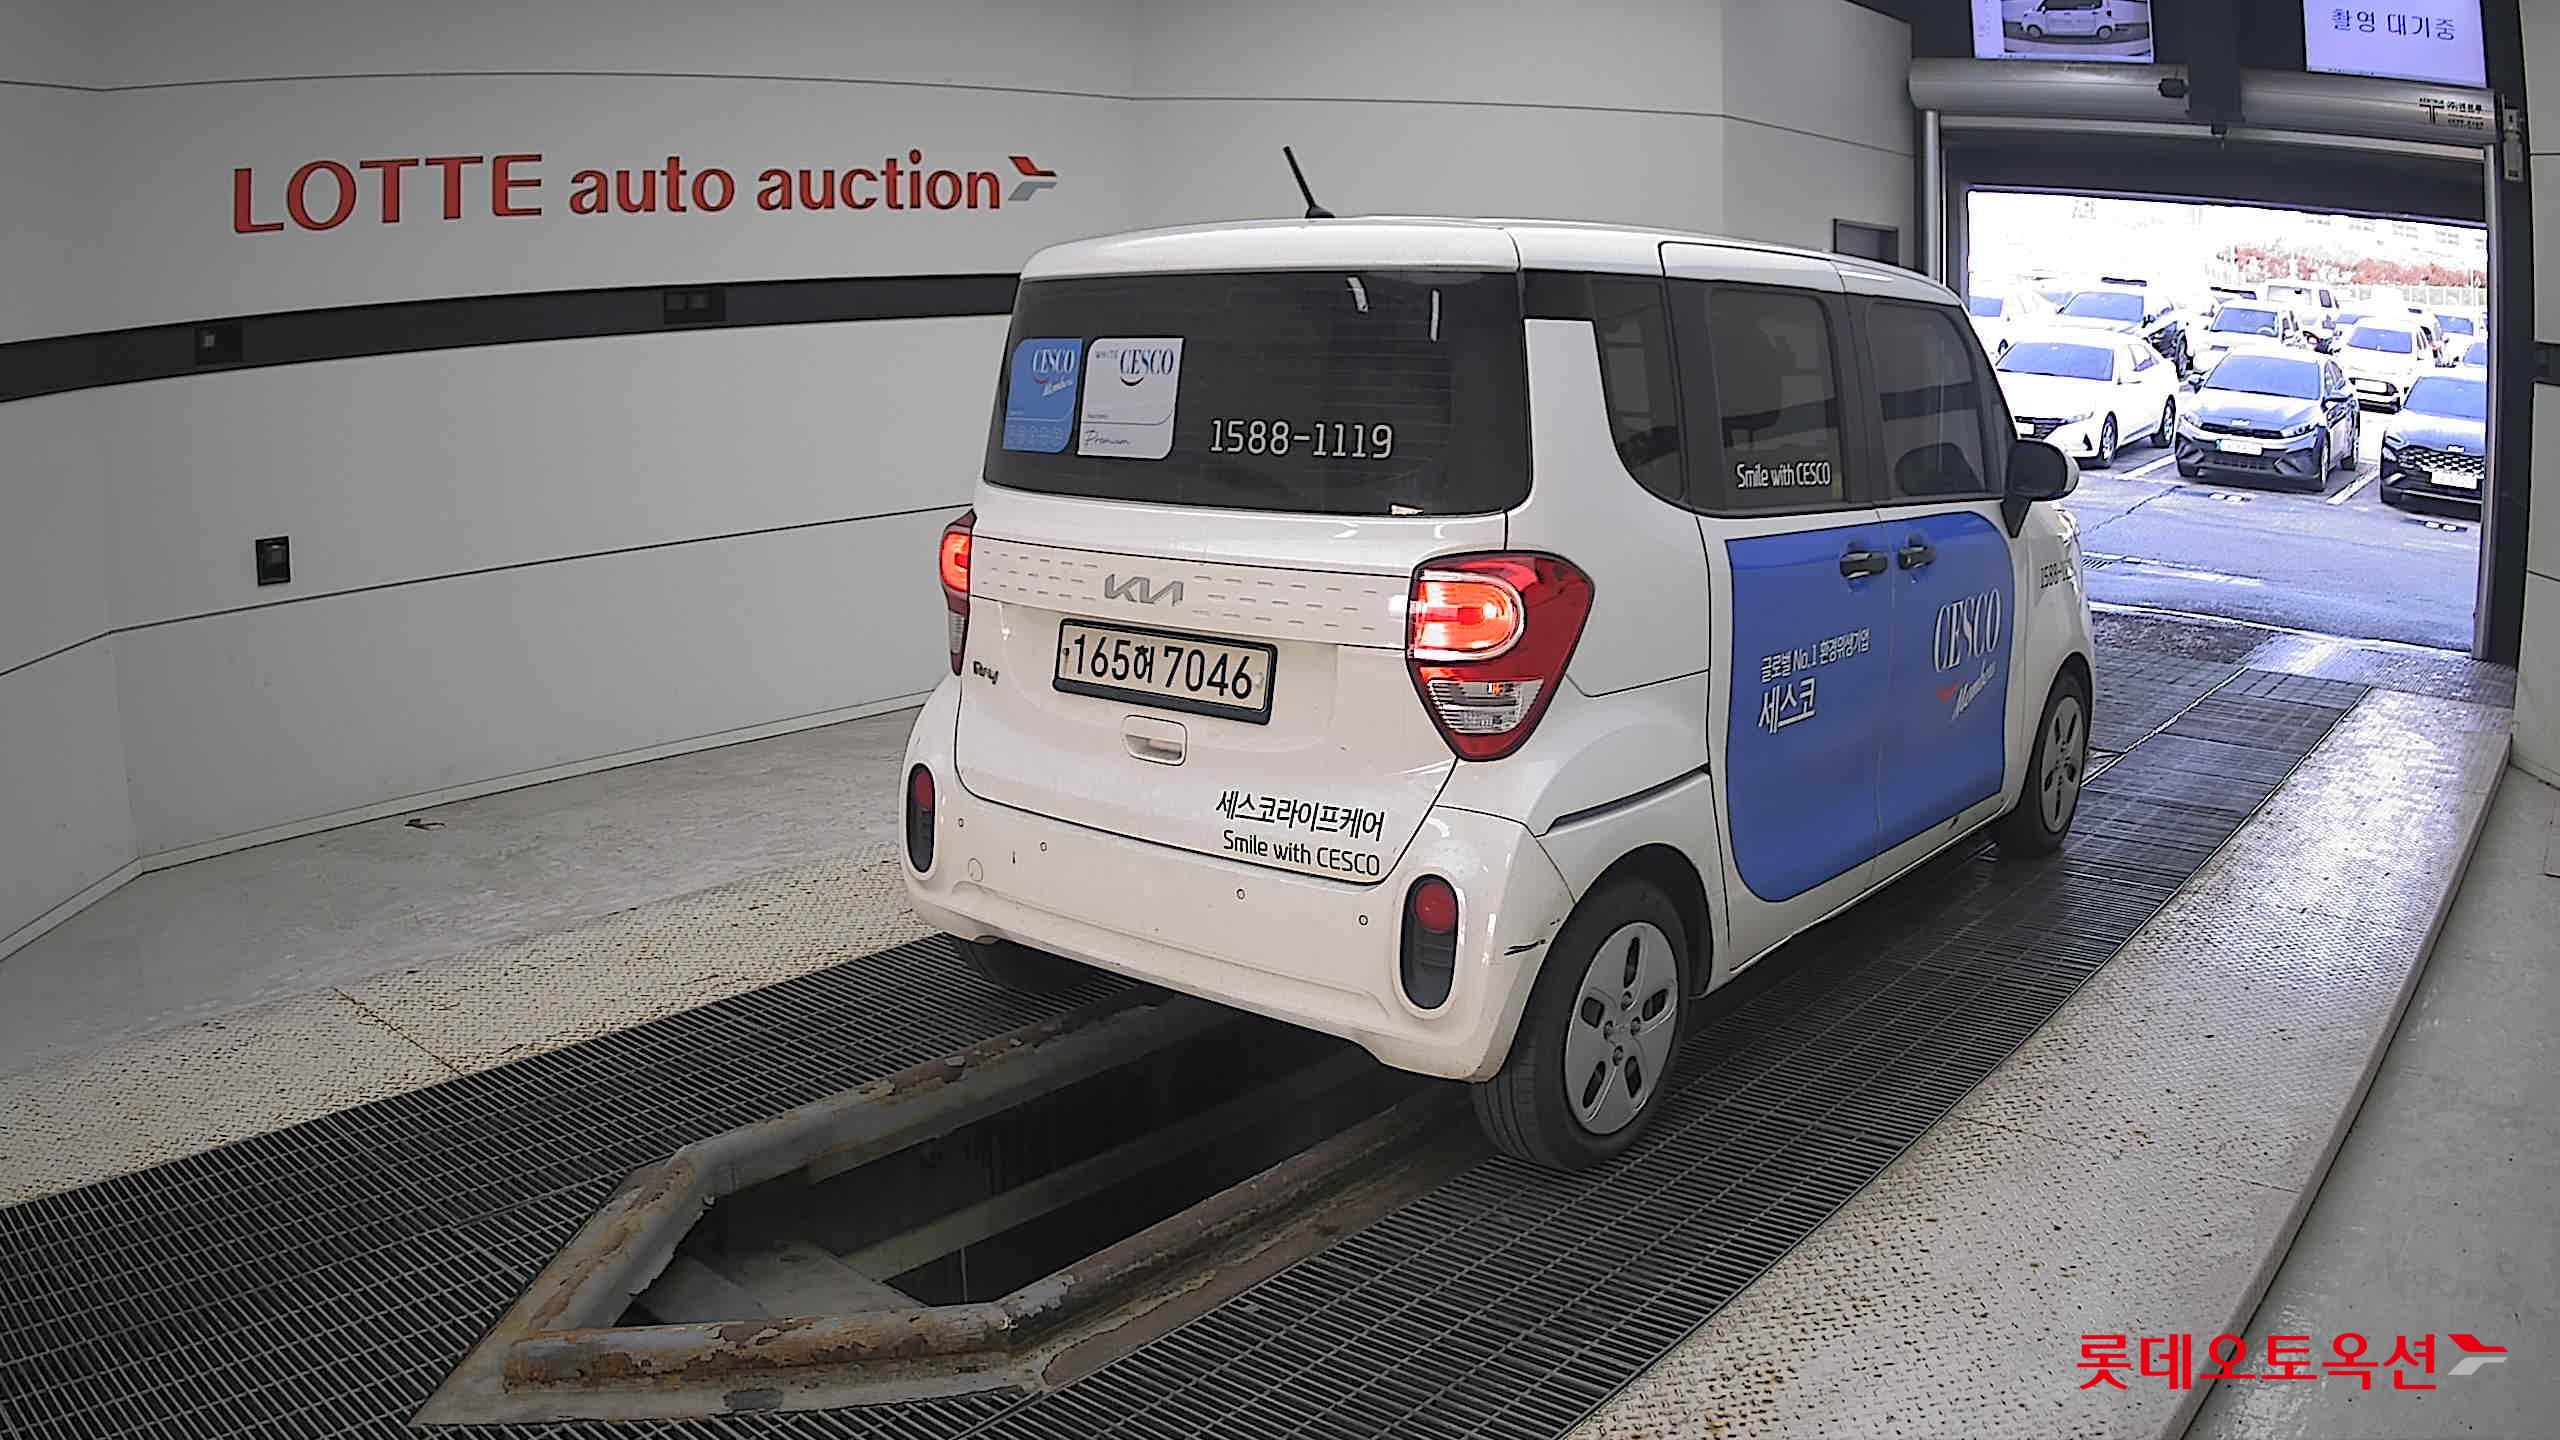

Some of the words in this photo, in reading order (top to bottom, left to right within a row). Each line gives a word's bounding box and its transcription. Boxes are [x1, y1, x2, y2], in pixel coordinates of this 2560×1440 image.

[234, 154, 543, 233] LOTTE
[568, 155, 735, 215] auto
[757, 148, 1002, 211] auction
[1032, 348, 1075, 374] CESCO
[1120, 348, 1174, 375] CESCO
[1210, 419, 1393, 459] 1588-1119
[1737, 463, 1769, 488] Smile
[1770, 463, 1795, 487] with
[1796, 462, 1831, 486] CESCO
[1103, 573, 1184, 607] KIA
[1934, 587, 2001, 672] CESCO
[1163, 645, 1252, 700] 7046
[1761, 651, 1792, 683] 글로벌
[1793, 644, 1817, 671] No.1
[1758, 677, 1816, 734] 세스코
[1216, 790, 1385, 842] 세스코라이프케어
[1223, 829, 1268, 857] Smile
[1273, 842, 1312, 865] with
[1316, 847, 1380, 876] CESCO
